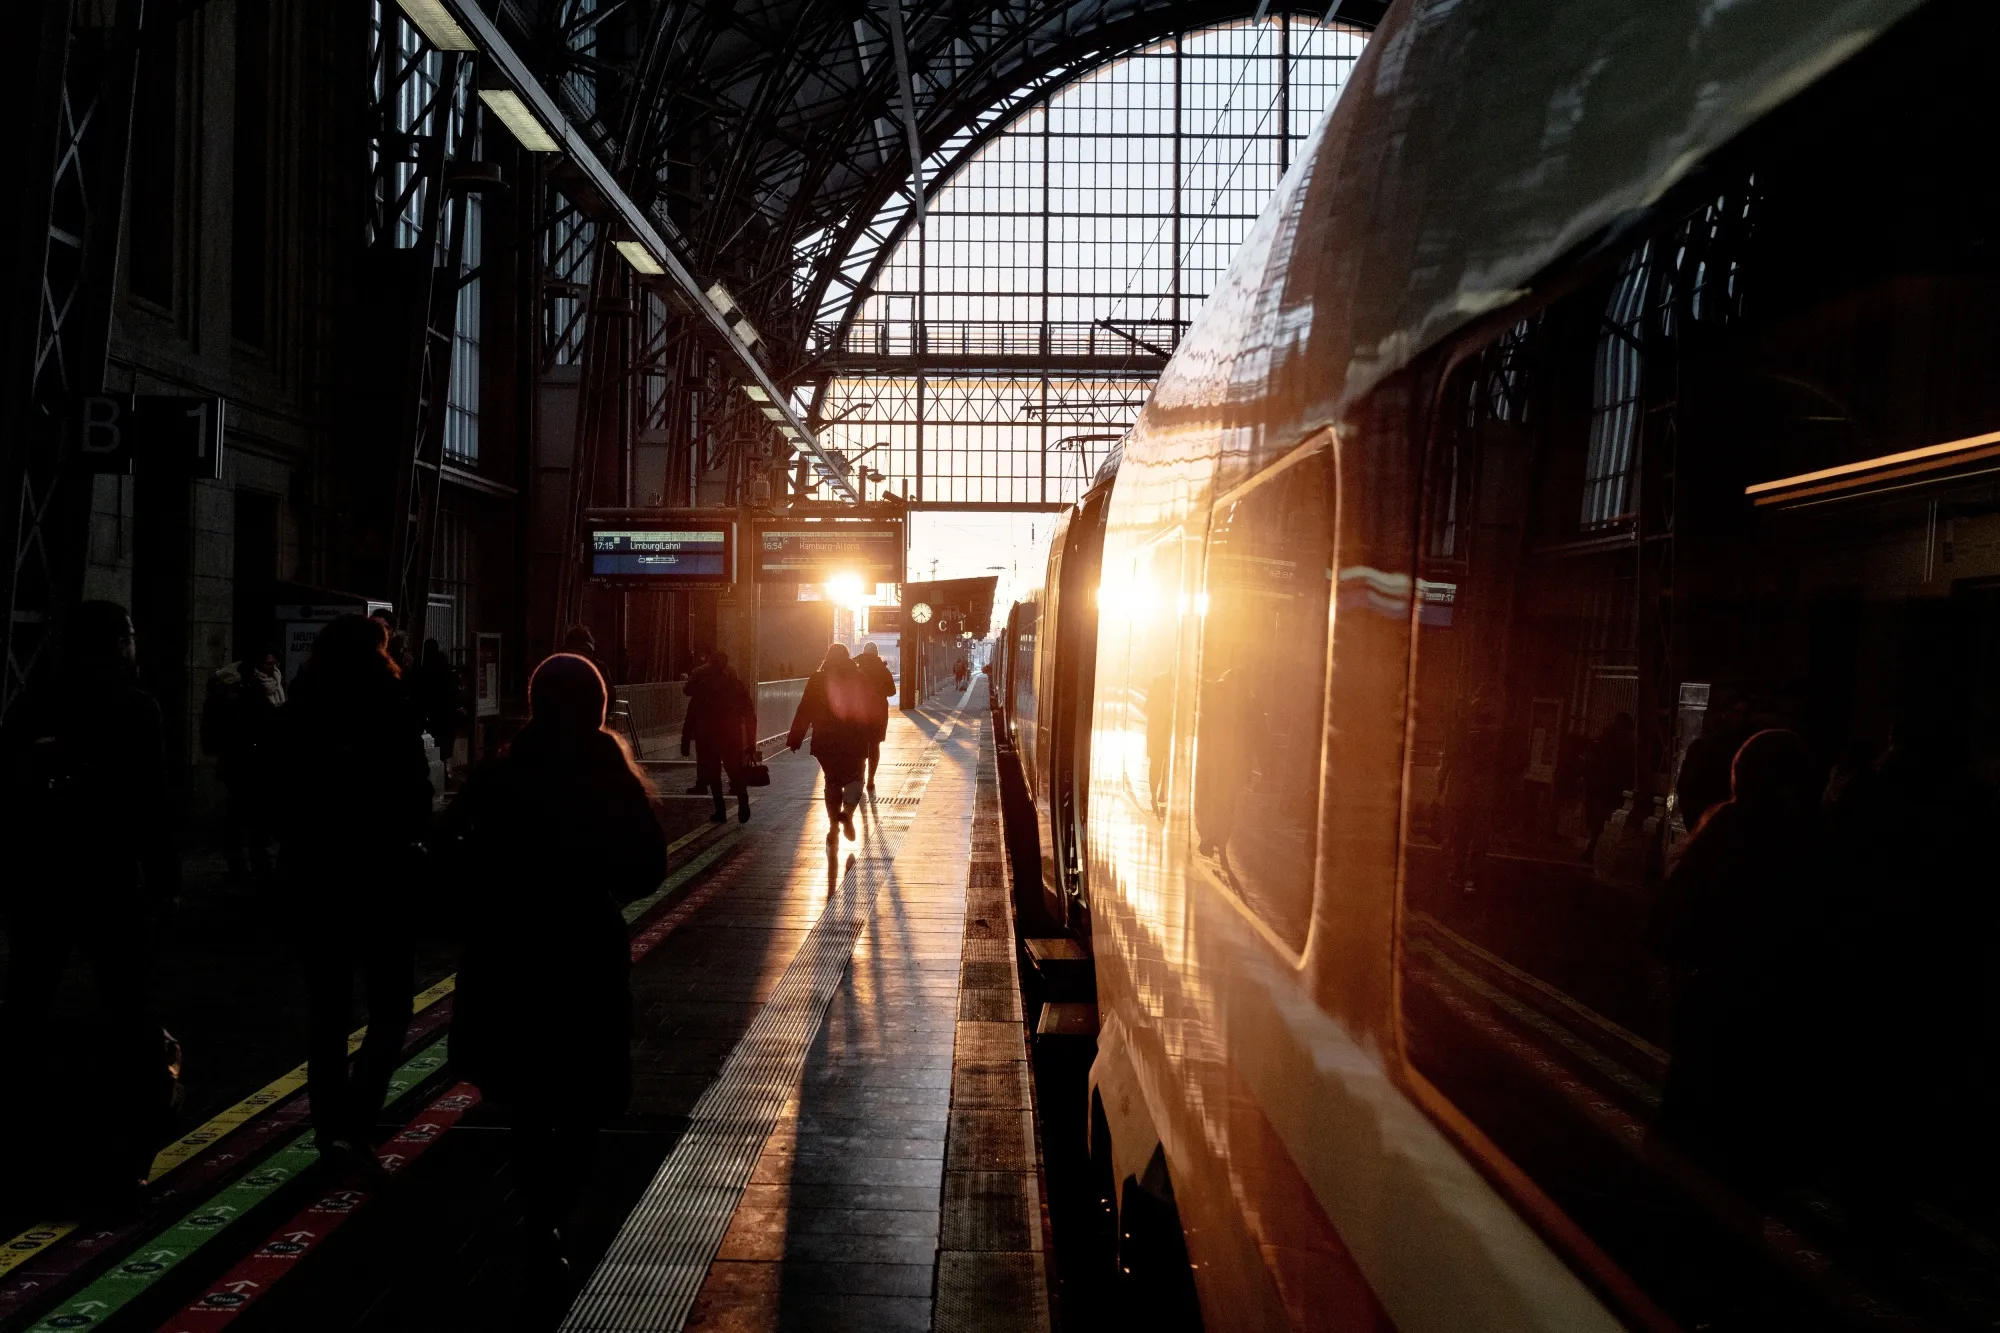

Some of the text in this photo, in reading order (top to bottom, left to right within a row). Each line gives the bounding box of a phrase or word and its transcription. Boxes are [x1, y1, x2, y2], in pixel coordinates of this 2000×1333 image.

[82, 396, 122, 454] B
[186, 401, 208, 459] 1
[593, 541, 614, 550] 17:15
[630, 541, 681, 552] Limburg(Lahn)
[799, 541, 860, 552] Hamburg-Altona
[938, 620, 947, 631] C
[958, 620, 963, 631] 1
